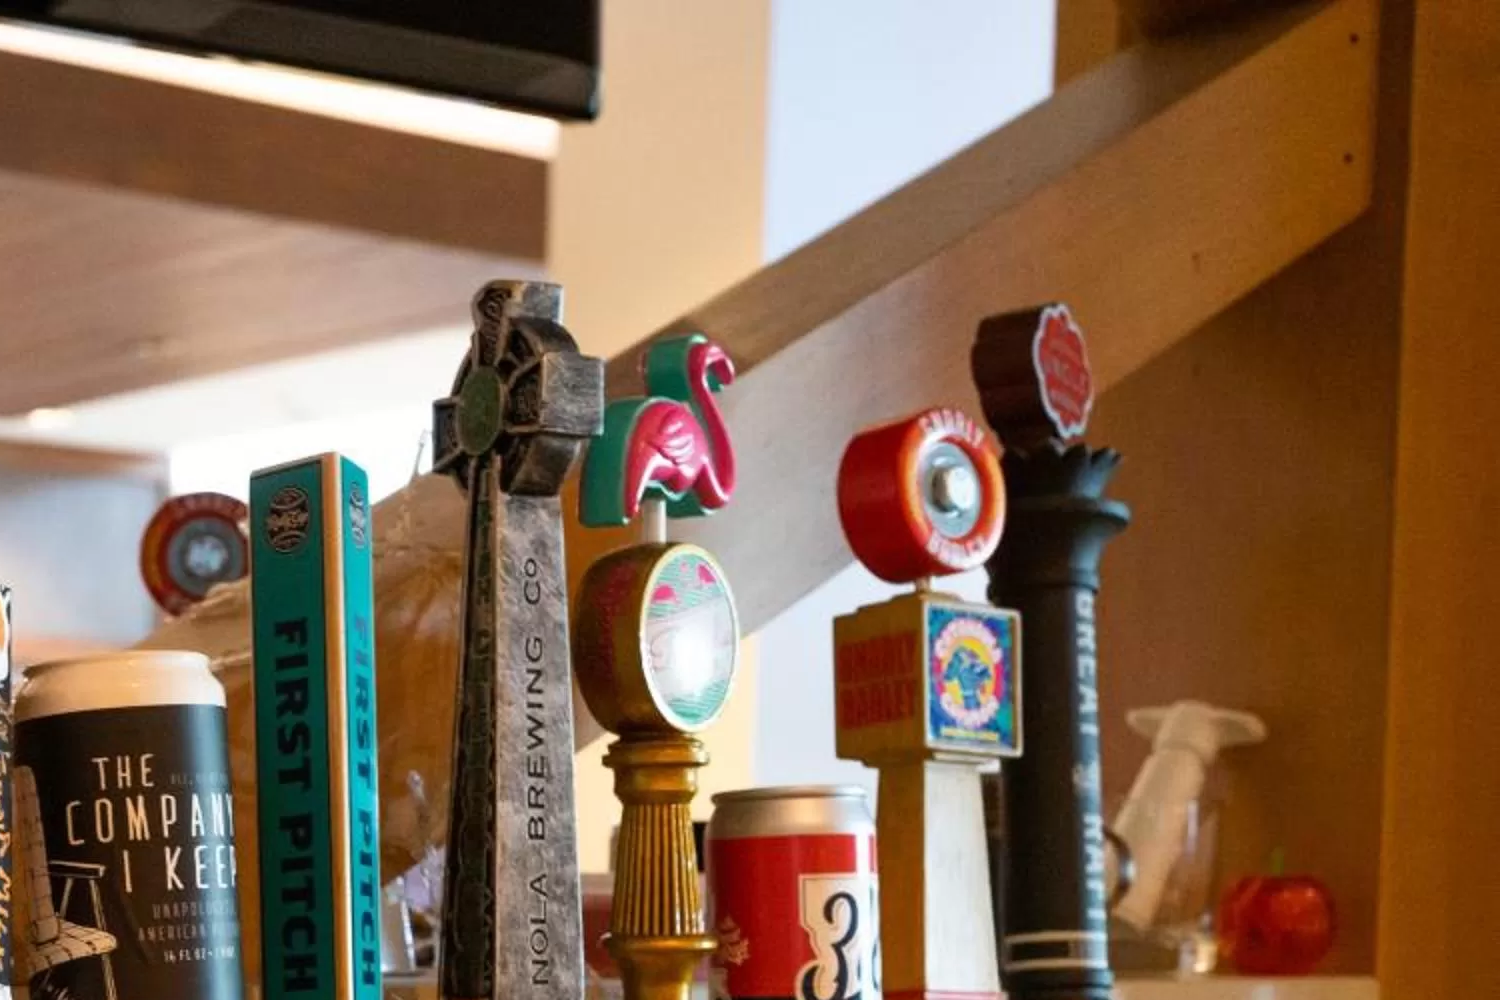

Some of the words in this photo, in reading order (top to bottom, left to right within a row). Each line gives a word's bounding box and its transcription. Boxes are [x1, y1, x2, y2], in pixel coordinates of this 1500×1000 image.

[91, 753, 156, 790] THE
[273, 616, 313, 790] FIRST
[353, 612, 374, 790] FIRST
[525, 634, 546, 841] BREWING
[66, 792, 235, 846] COMPANY
[123, 849, 133, 893] I
[278, 811, 318, 994] PITCH
[357, 820, 378, 988] PITCH
[531, 869, 551, 987] NOLA
